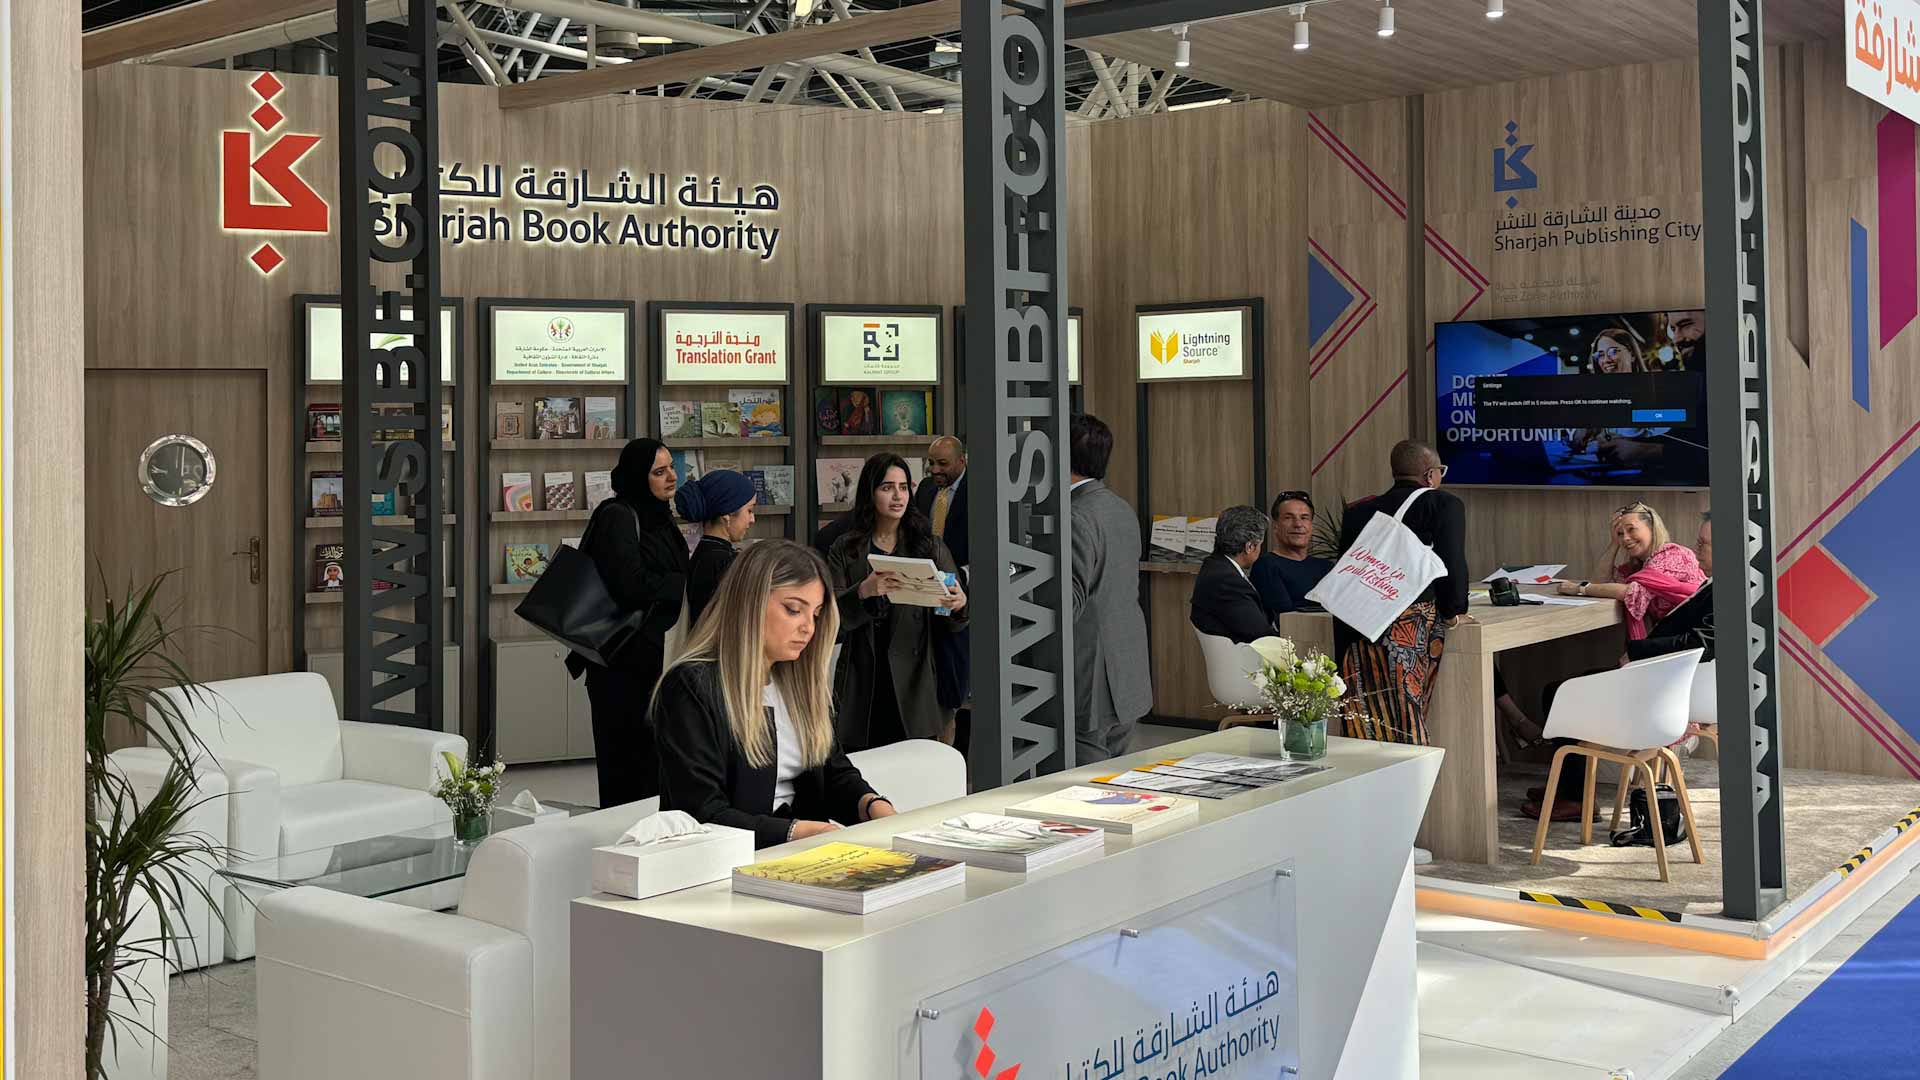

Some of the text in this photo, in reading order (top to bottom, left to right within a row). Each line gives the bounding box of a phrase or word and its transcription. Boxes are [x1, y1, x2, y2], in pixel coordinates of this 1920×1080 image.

[1854, 0, 1920, 95] شارقة
[514, 168, 666, 208] الشارقة
[678, 175, 780, 215] هيئة
[523, 209, 611, 245] Book
[619, 213, 780, 260] Authority
[1494, 204, 1661, 234] مدينة الشارقة للنشر
[1494, 221, 1702, 252] Sharjah Publishing City
[675, 330, 760, 348] منحة الترجمة
[675, 348, 777, 364] Translation Grant
[1183, 332, 1231, 347] Lightning
[1183, 345, 1219, 358] Source
[367, 45, 427, 728] WW.SIBF.COM
[999, 0, 1057, 784] WW.SIBF.CO
[1446, 427, 1577, 442] OPPORTUNITY
[1350, 546, 1405, 580] Women in
[1224, 970, 1280, 1018] هيئة
[1133, 991, 1219, 1064] الشارقة
[1194, 1014, 1281, 1080] Authority
